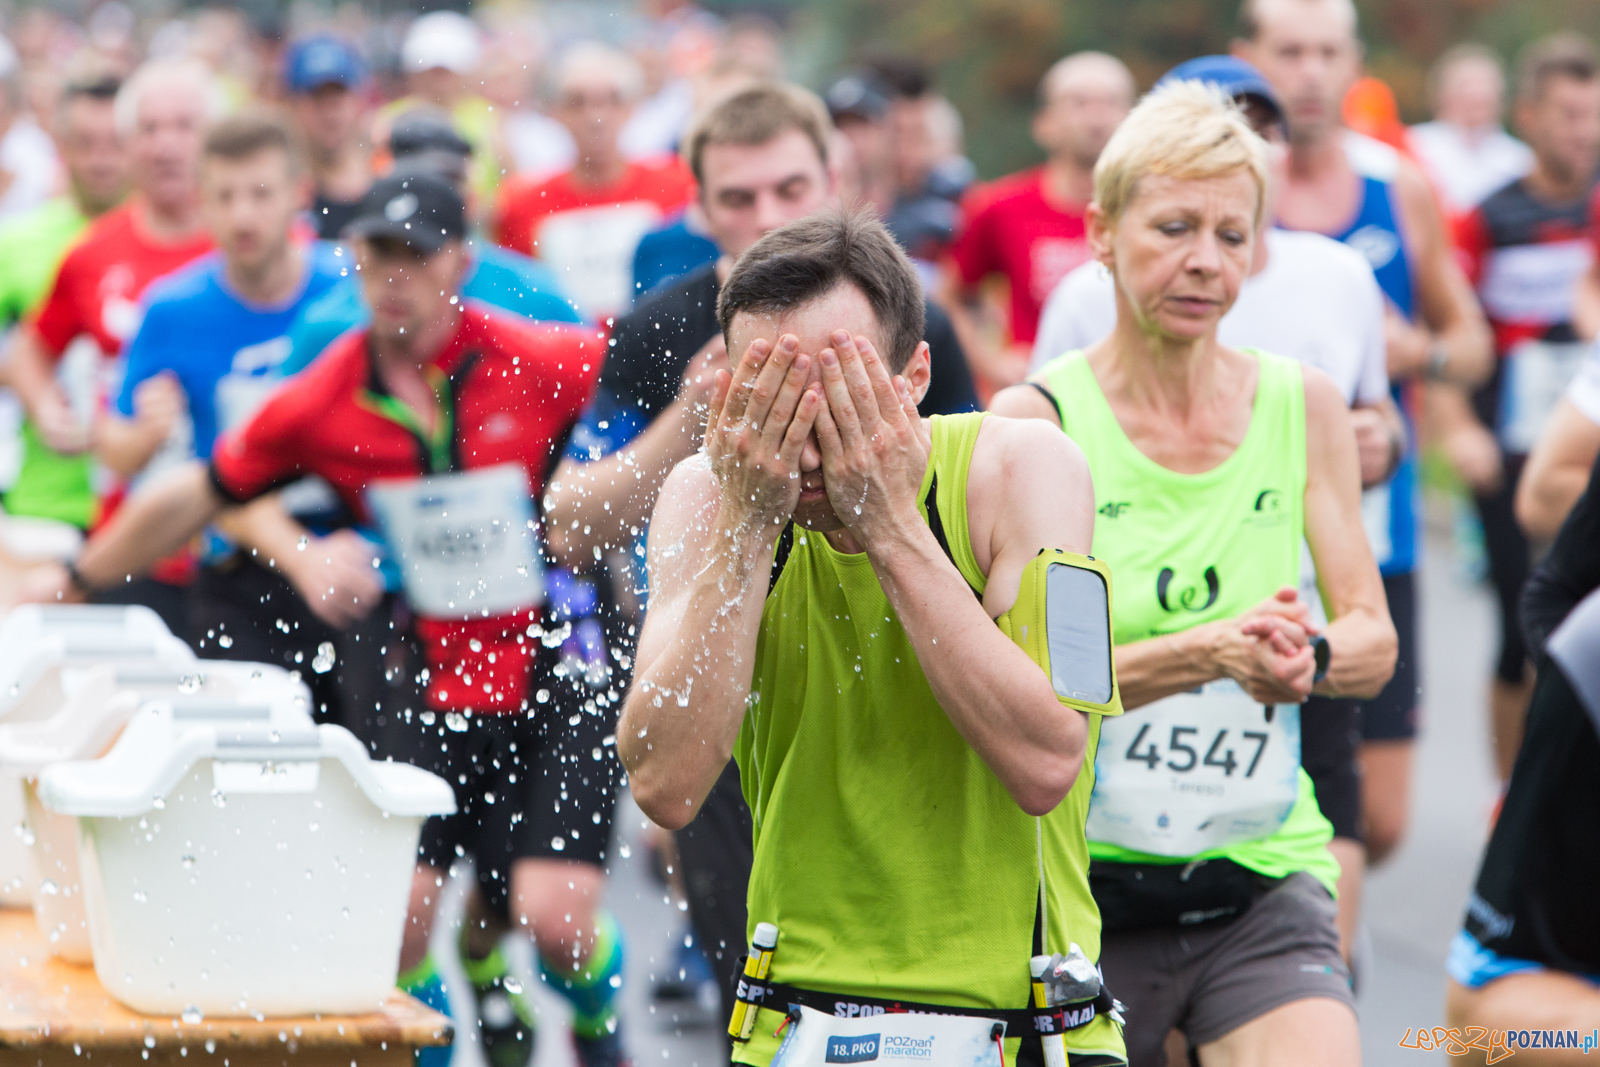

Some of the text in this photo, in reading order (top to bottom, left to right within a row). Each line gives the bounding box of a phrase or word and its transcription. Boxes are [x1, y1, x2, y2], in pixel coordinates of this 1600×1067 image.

[1125, 723, 1269, 778] 4547
[832, 1041, 876, 1056] 18. PKO
[883, 1047, 932, 1057] maraton
